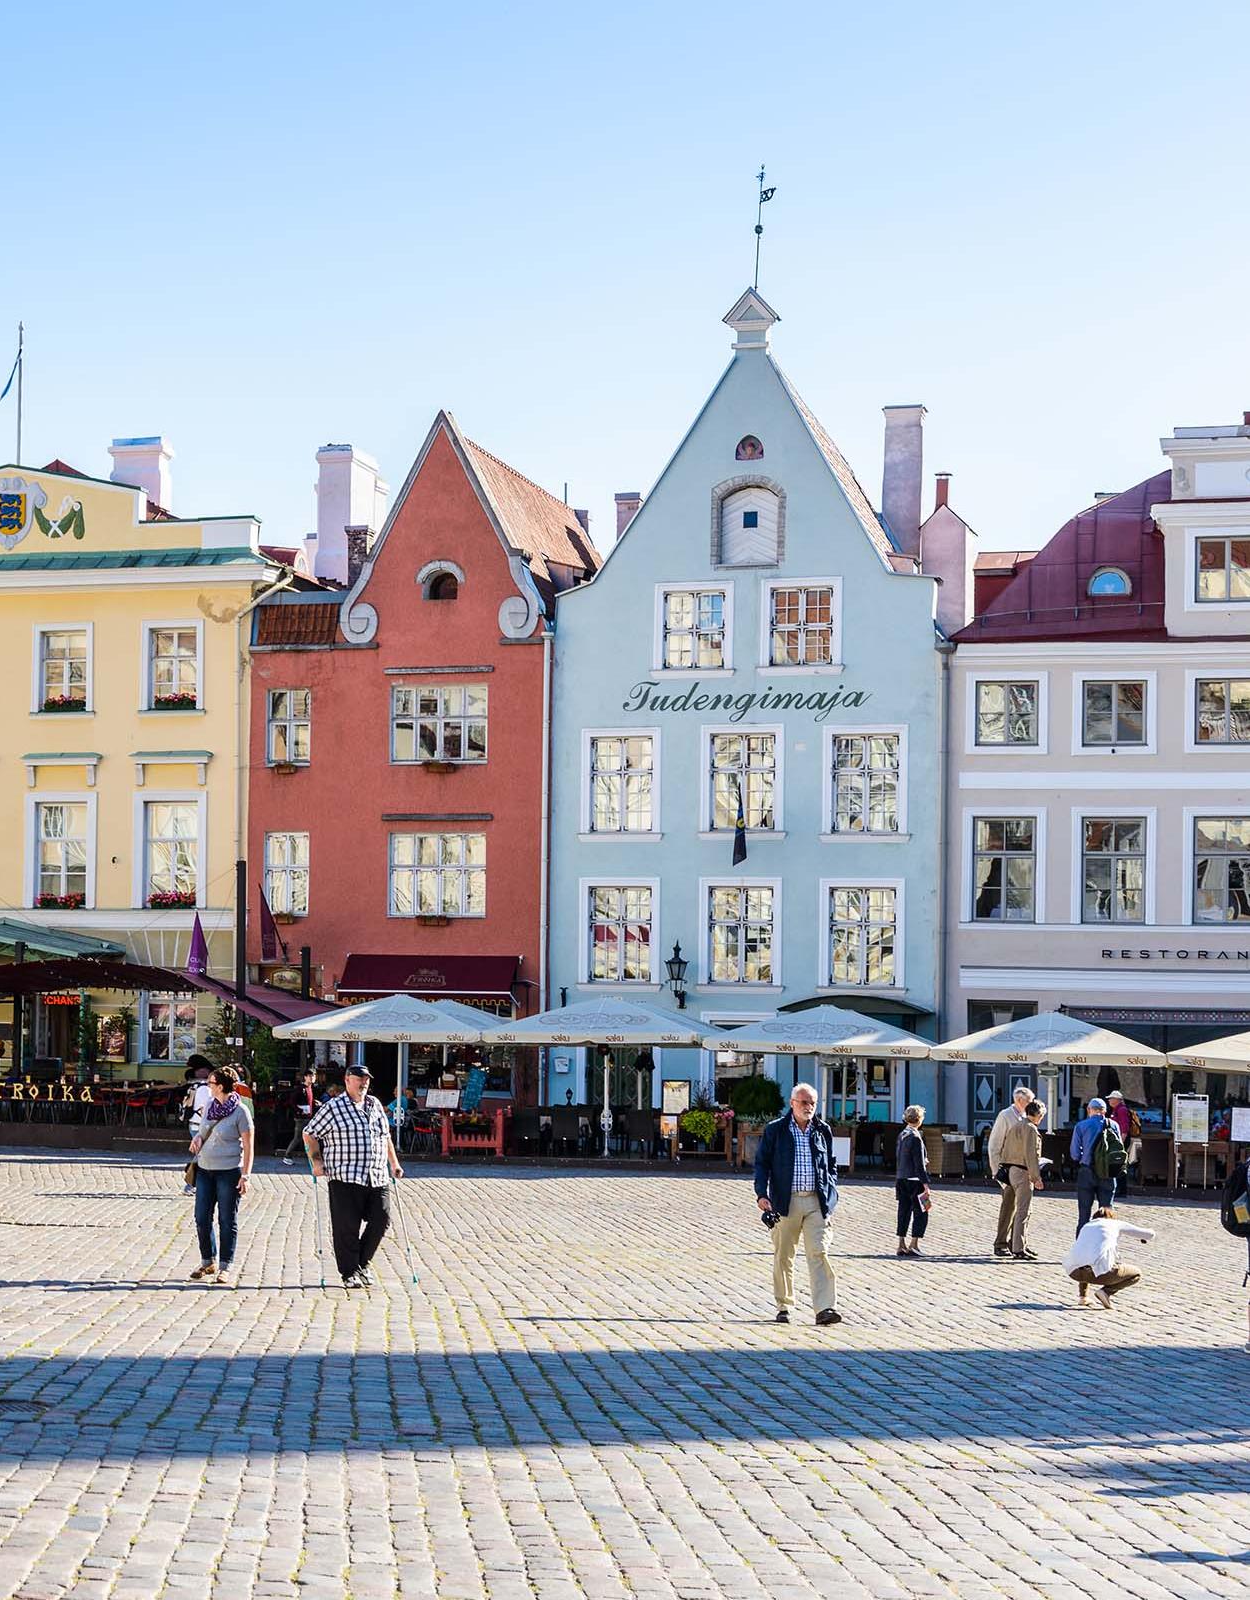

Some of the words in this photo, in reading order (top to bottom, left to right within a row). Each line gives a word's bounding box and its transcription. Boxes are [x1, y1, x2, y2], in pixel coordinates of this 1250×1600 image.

[622, 681, 872, 722] Tudengimaja
[1101, 949, 1249, 960] RESTORAN
[290, 1029, 308, 1038] saku
[342, 1031, 360, 1040] saku
[393, 1032, 412, 1041] saku
[446, 1033, 464, 1042] saku
[497, 1033, 516, 1041] saku
[551, 1033, 570, 1042] saku
[605, 1033, 624, 1042] saku
[661, 1033, 679, 1041] saku
[719, 1041, 739, 1050] saku
[776, 1043, 796, 1052] saku
[832, 1045, 852, 1053] saku
[890, 1047, 910, 1055] saku
[948, 1051, 968, 1060] saku
[1006, 1053, 1027, 1062] saku
[1066, 1054, 1087, 1063] saku
[1127, 1056, 1147, 1065] saku
